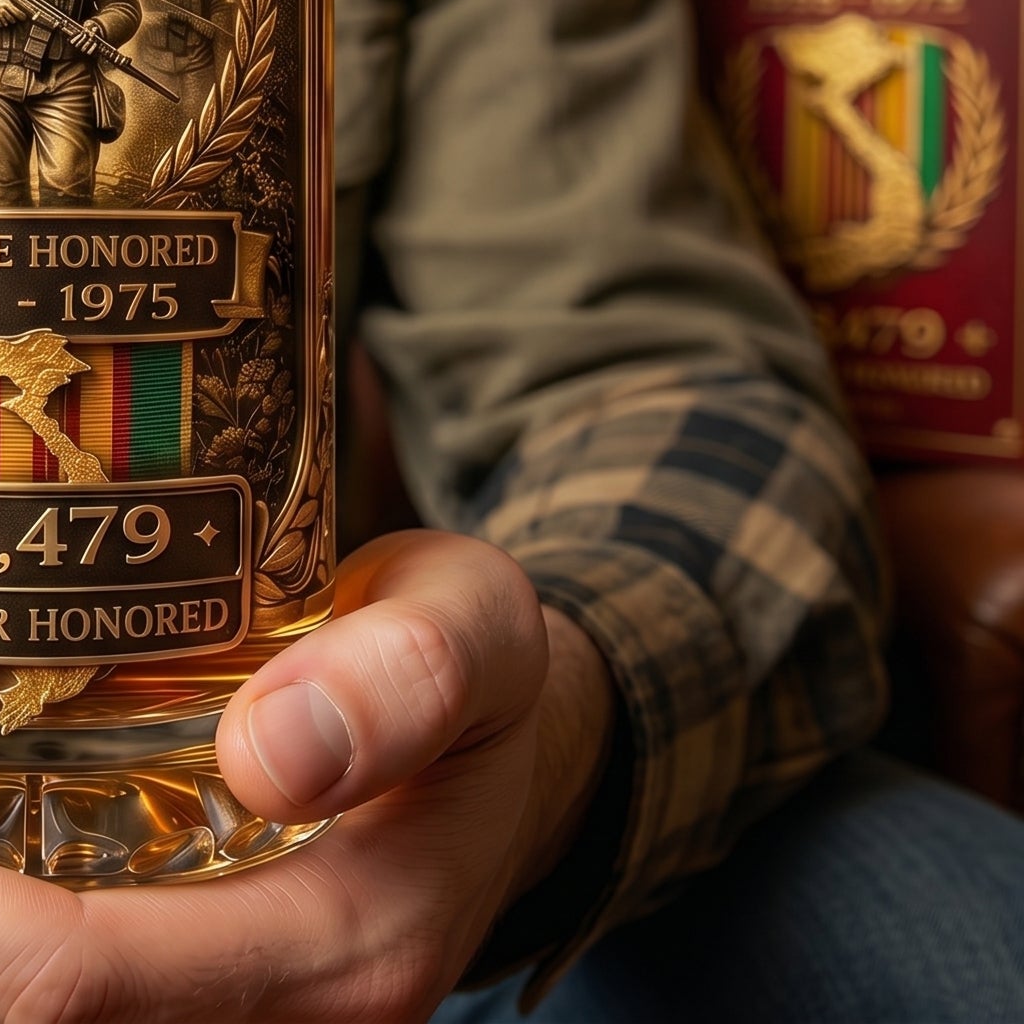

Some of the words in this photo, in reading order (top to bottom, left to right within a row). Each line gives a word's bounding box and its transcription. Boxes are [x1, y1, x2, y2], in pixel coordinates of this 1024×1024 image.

[29, 234, 218, 268] HONORED
[60, 283, 178, 321] 1975
[28, 598, 229, 642] HONORED
